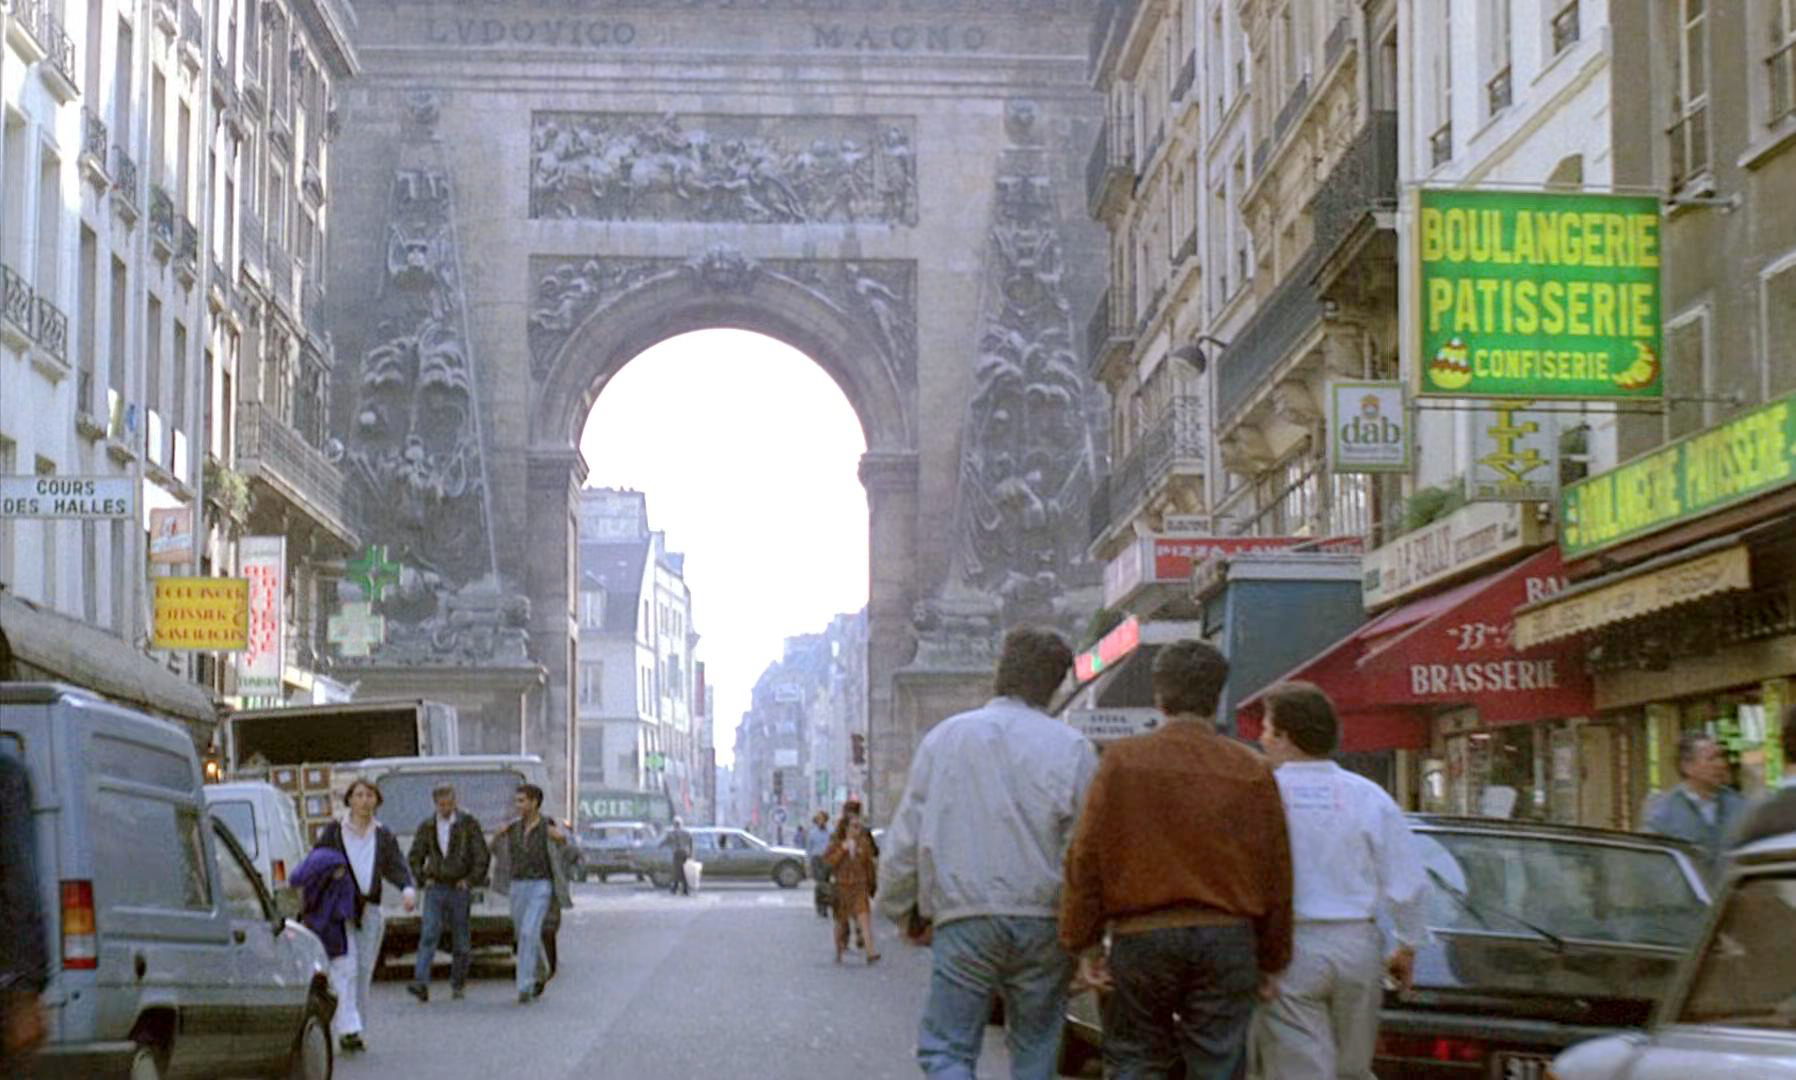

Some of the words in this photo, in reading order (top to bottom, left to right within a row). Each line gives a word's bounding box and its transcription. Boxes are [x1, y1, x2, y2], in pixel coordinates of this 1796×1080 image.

[428, 18, 636, 45] LVDOVICO
[813, 24, 986, 50] MAGNO
[1421, 207, 1660, 268] BOULANGERIE
[1428, 277, 1656, 337] PATISSERIE
[1473, 348, 1610, 381] CONFISERIE
[1340, 415, 1401, 445] dab
[36, 479, 96, 496] COURS
[3, 498, 40, 514] DES
[54, 498, 127, 514] HALLES
[1410, 659, 1560, 696] BRASSERIE
